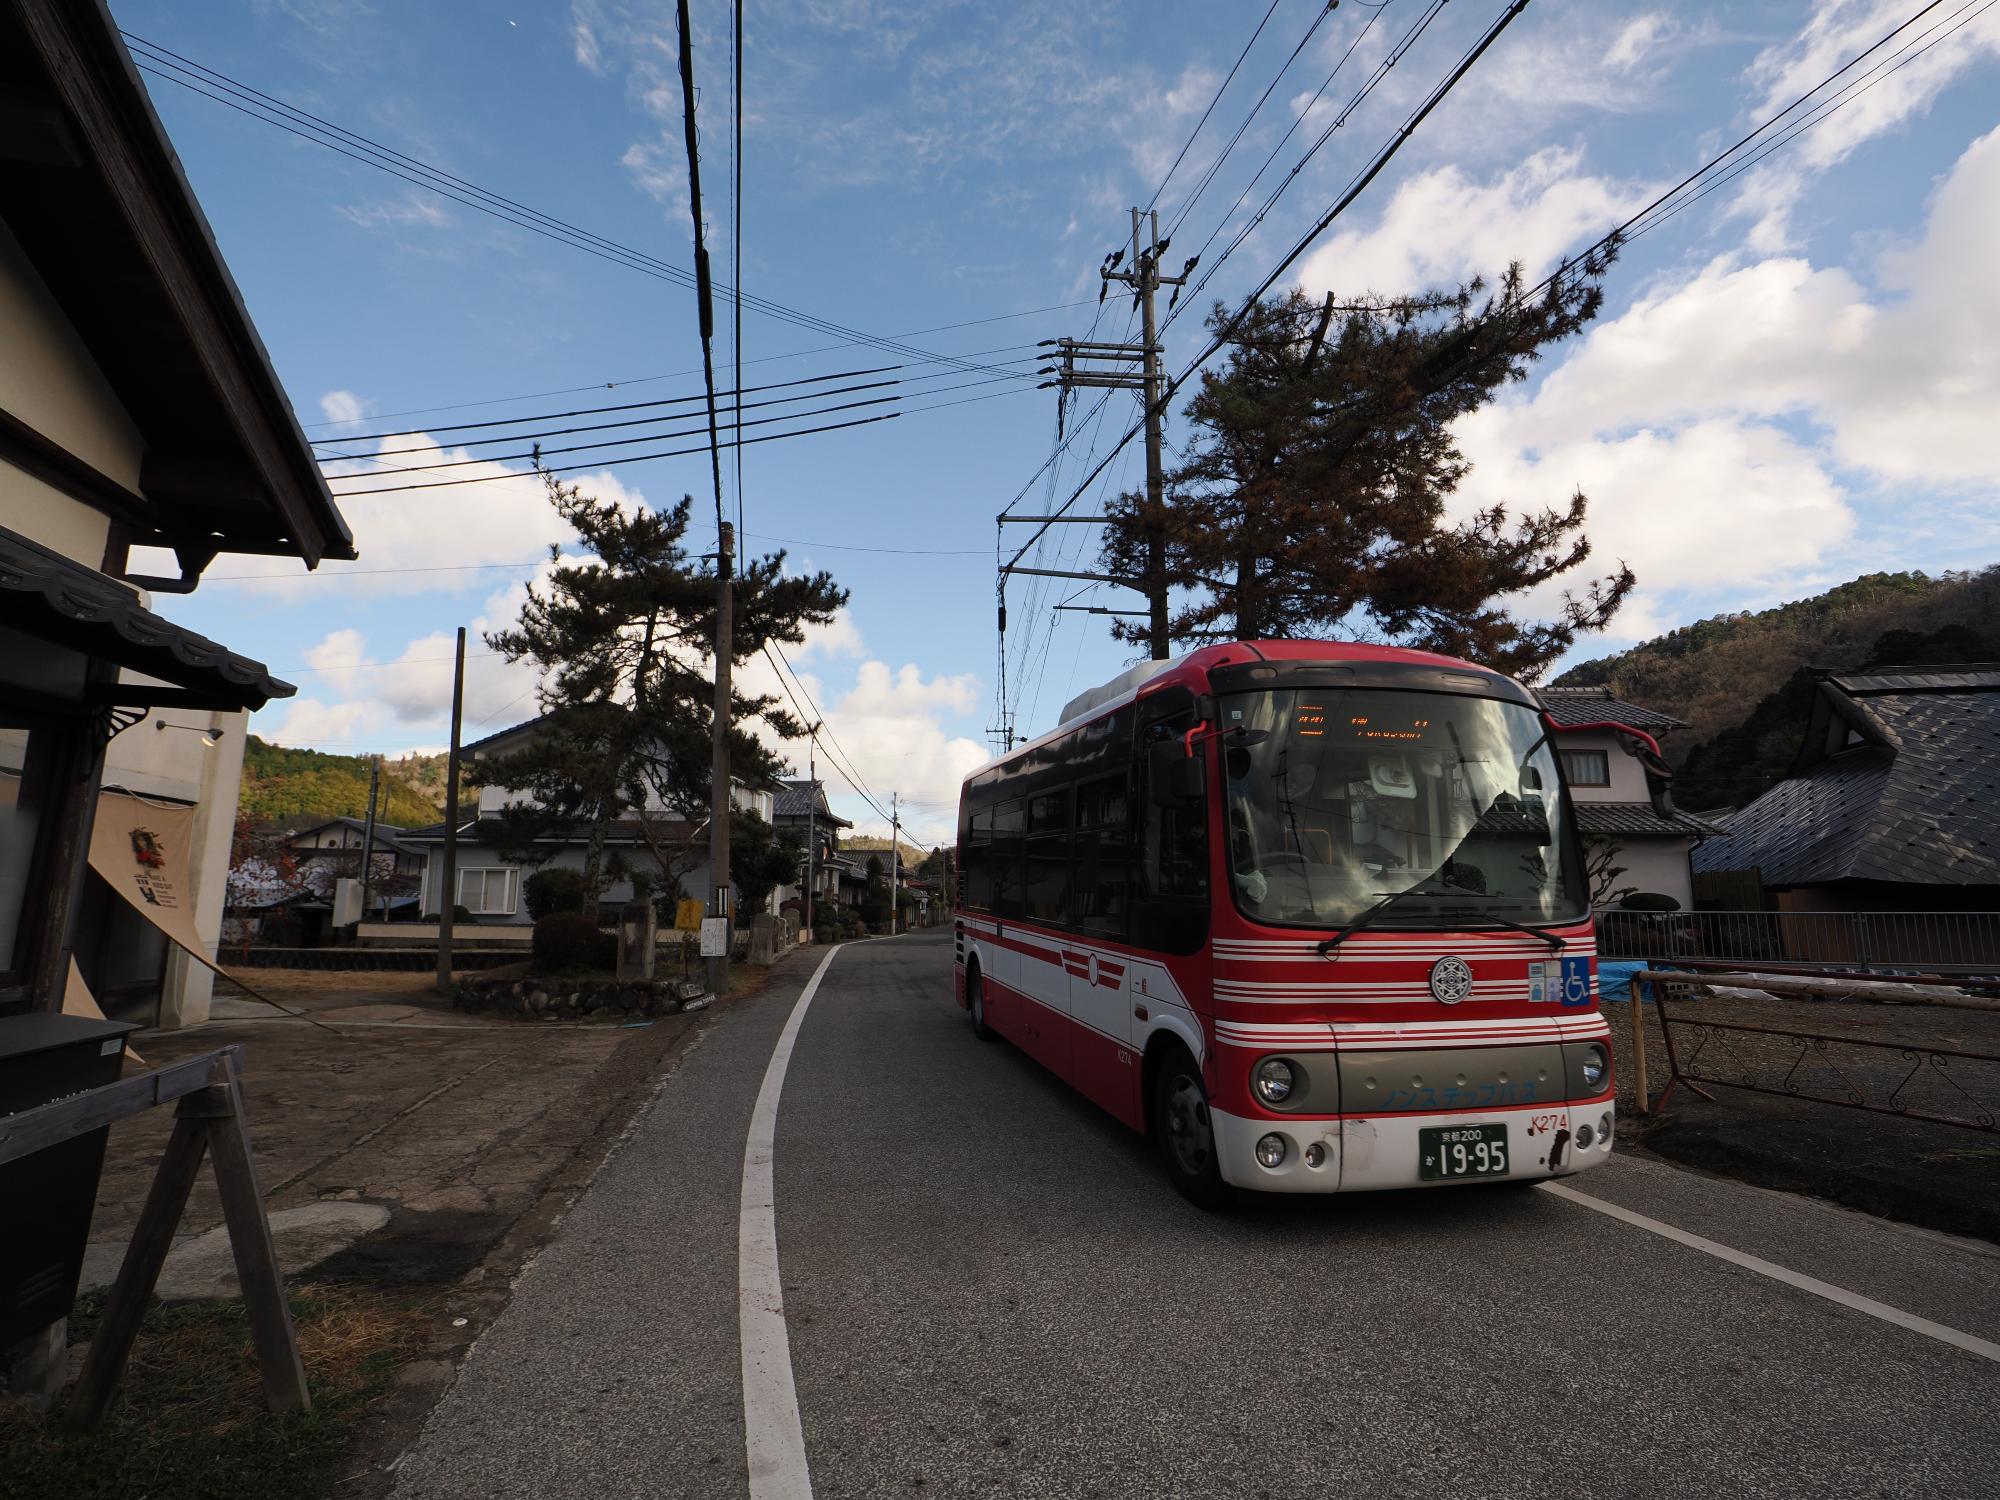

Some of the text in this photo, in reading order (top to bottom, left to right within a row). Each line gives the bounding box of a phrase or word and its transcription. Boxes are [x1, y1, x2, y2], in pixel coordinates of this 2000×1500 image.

[1118, 1049, 1131, 1067] K274
[1380, 1081, 1537, 1109] ノンステップバス
[1531, 1114, 1568, 1132] K274
[1440, 1141, 1505, 1175] 19-95
